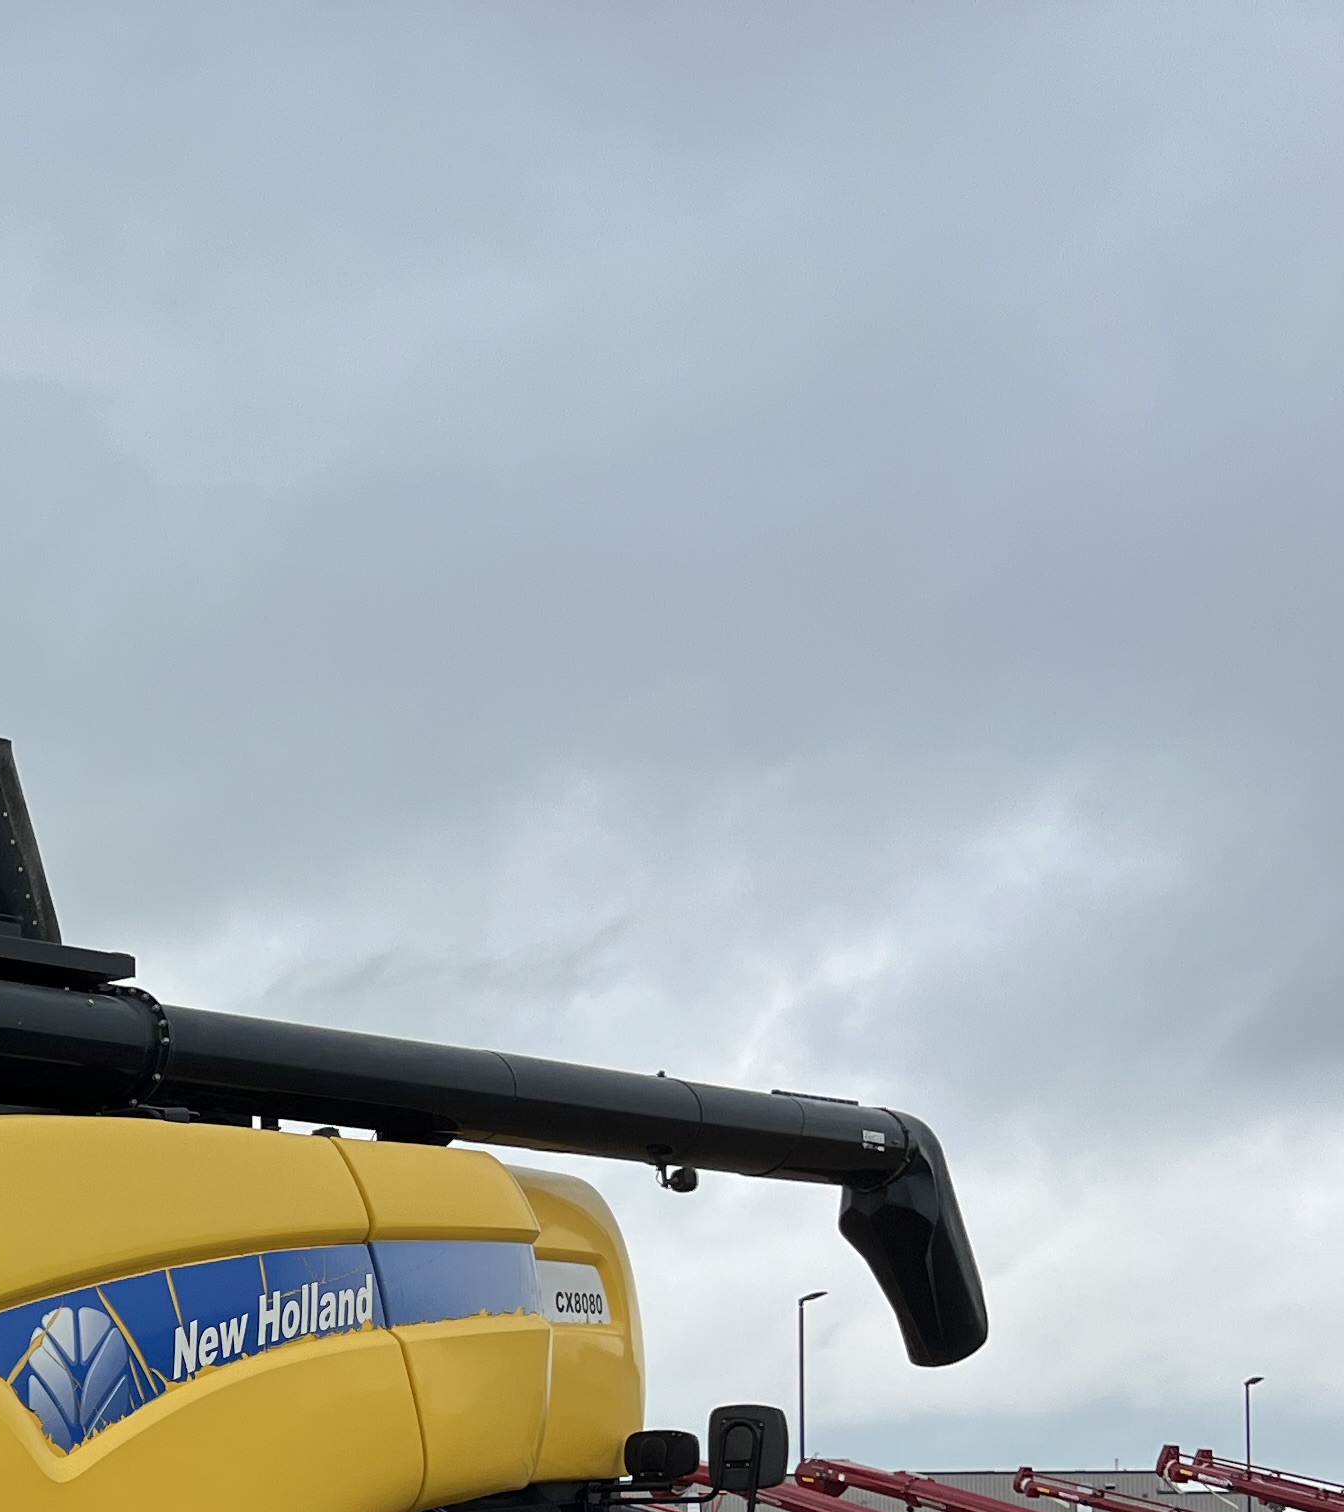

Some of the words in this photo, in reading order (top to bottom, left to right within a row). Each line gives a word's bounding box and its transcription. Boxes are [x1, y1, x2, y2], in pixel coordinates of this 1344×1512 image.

[173, 1312, 249, 1380] New
[257, 1273, 373, 1347] Holland
[555, 1291, 603, 1315] CX8080
